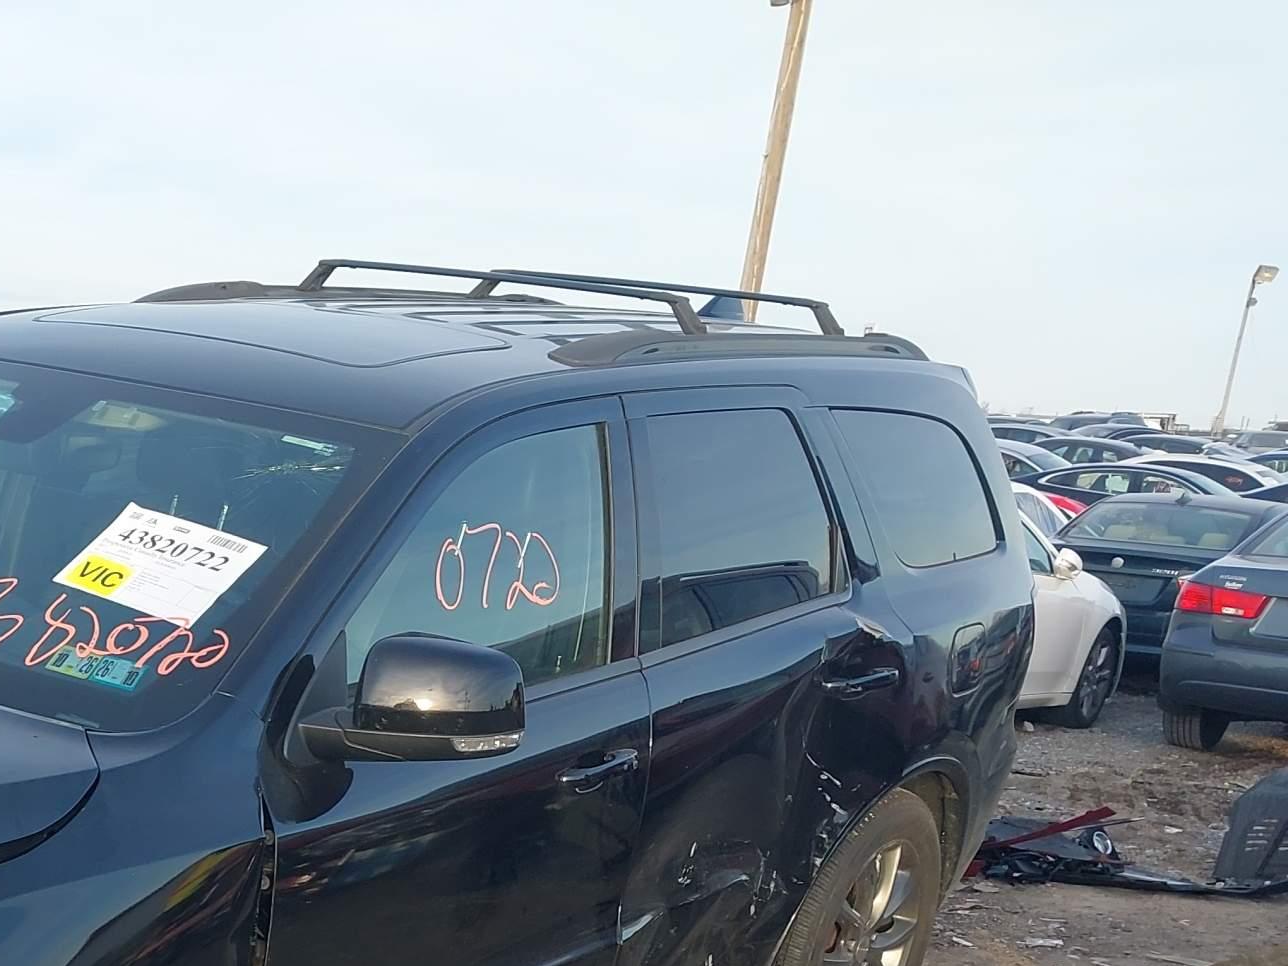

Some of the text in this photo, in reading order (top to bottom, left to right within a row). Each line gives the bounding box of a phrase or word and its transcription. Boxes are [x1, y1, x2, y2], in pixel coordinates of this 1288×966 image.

[118, 528, 230, 572] 43820722
[79, 561, 124, 588] VIC
[52, 652, 70, 668] 10
[123, 670, 140, 686] 10
